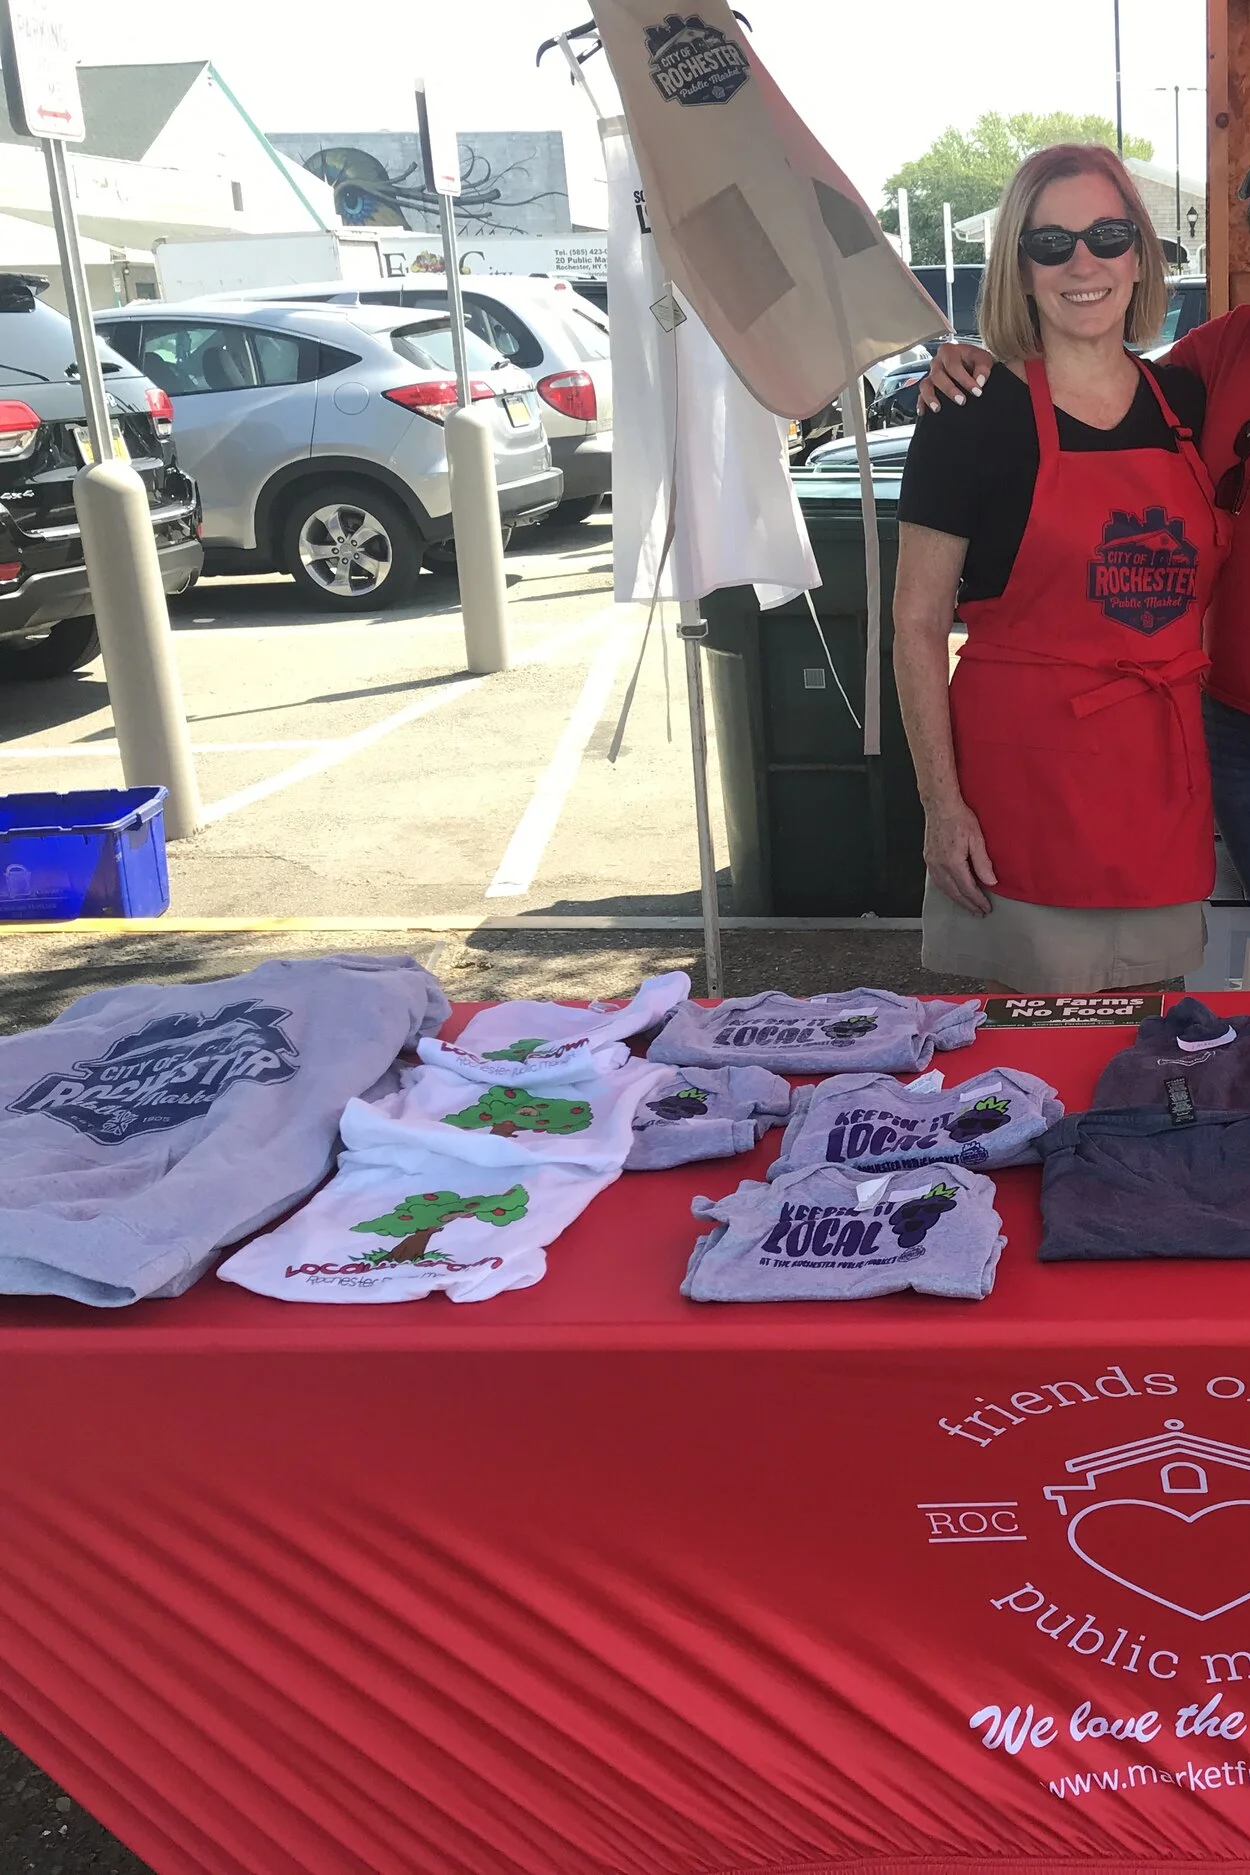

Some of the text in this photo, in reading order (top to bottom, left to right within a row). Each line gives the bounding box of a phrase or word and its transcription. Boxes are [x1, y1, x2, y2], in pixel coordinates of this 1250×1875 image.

[657, 45, 745, 96] ROCHESTER
[661, 47, 692, 67] CITY OF
[680, 67, 741, 98] Public Market
[567, 256, 593, 264] Public
[1107, 550, 1147, 565] CITY OF
[1095, 565, 1196, 598] ROCHESTER
[1110, 596, 1182, 609] Public Market
[1006, 998, 1144, 1008] No Farms
[1011, 1005, 1134, 1018] No Food
[712, 1025, 816, 1047] LOCAL
[27, 1047, 281, 1110] ROCHESTER
[100, 1053, 185, 1083] CITY OF
[133, 1090, 216, 1108] Marke
[825, 1122, 940, 1163] LOCAL
[761, 1218, 883, 1257] LOCAL
[759, 1257, 773, 1266] AT
[773, 1259, 790, 1268] THE
[791, 1260, 836, 1269] ROCHESTER
[837, 1260, 864, 1269] PUBLIC
[938, 1366, 1179, 1448] friends
[925, 1511, 1020, 1535] ROC
[988, 1581, 1180, 1680] public
[968, 1704, 1059, 1754] We
[1070, 1700, 1163, 1742] love
[1174, 1692, 1249, 1740] the
